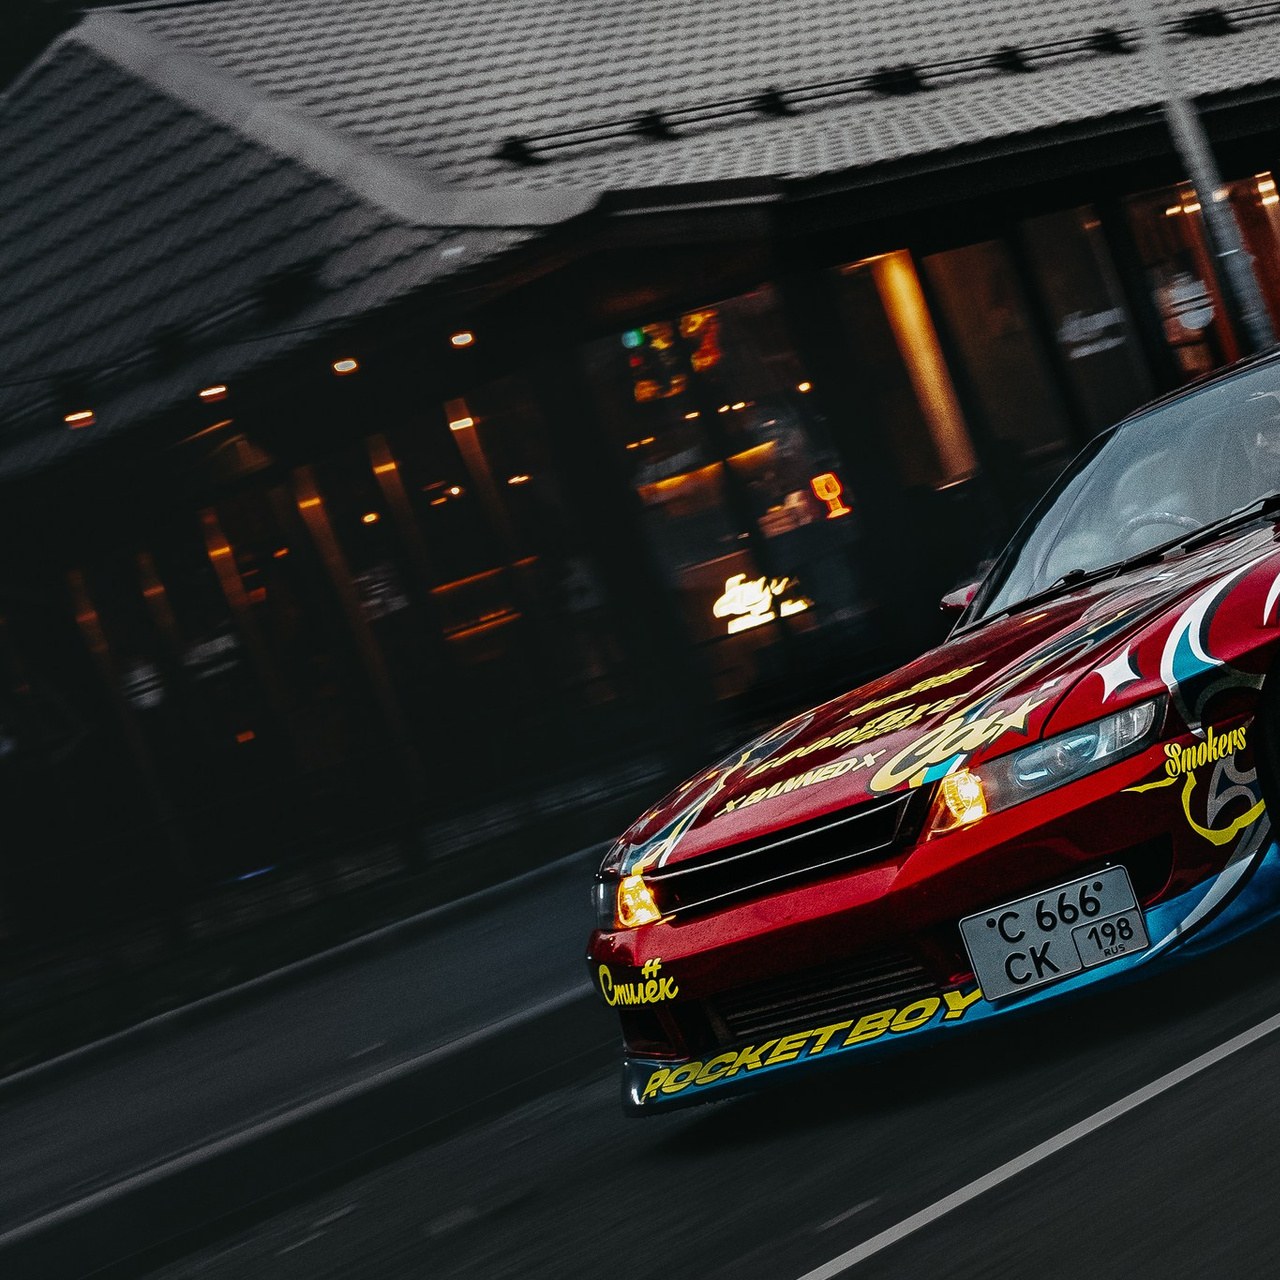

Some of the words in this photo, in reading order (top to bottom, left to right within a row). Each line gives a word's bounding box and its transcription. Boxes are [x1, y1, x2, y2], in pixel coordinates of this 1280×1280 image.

[1164, 726, 1247, 778] Smokers
[1035, 884, 1101, 933] 666
[1086, 917, 1134, 950] 198
[1104, 943, 1126, 957] RUS
[1004, 940, 1061, 985] СК
